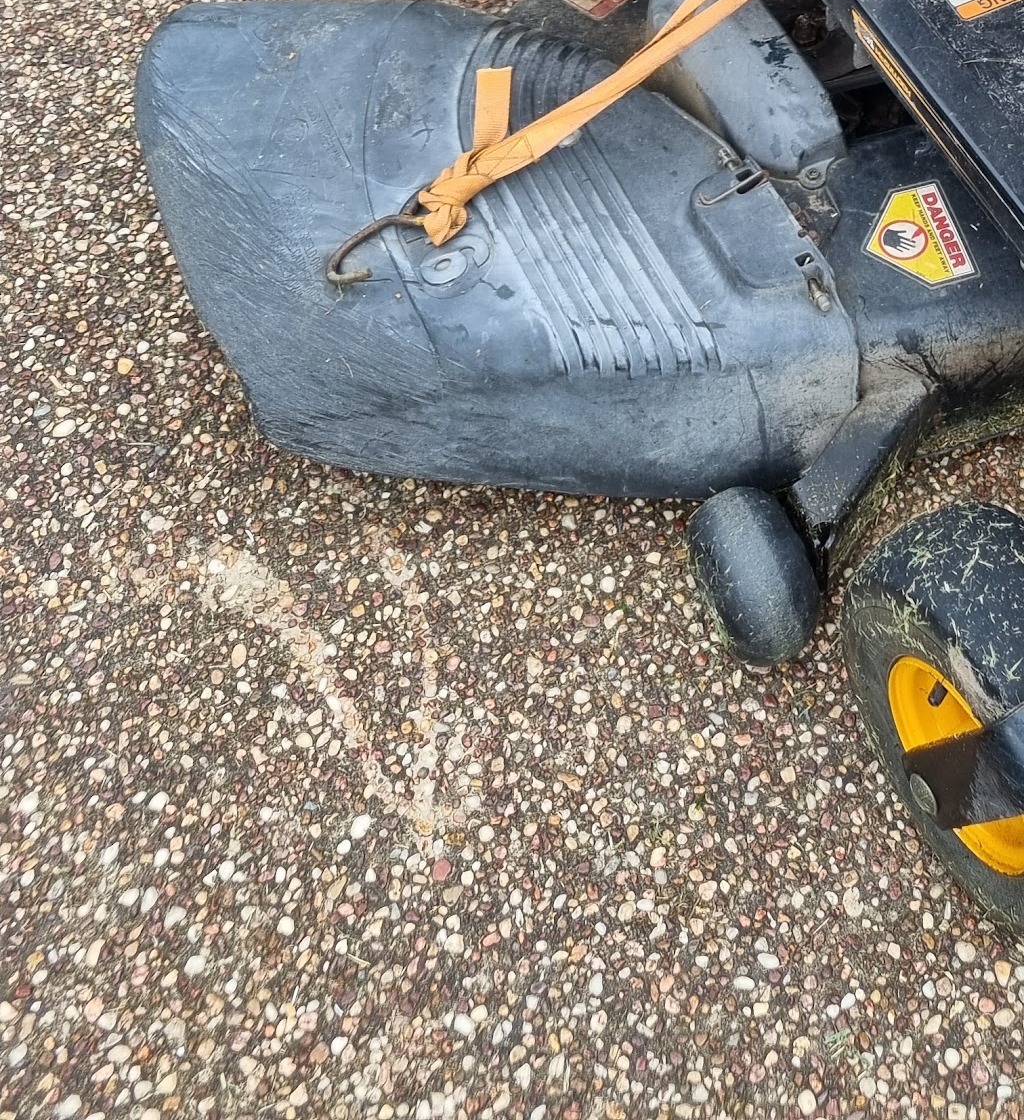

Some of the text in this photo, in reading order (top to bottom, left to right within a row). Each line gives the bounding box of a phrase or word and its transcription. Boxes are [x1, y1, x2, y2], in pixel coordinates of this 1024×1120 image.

[911, 193, 950, 273] KEEP HANDS AND FEET AWAY
[922, 192, 966, 269] DANGER
